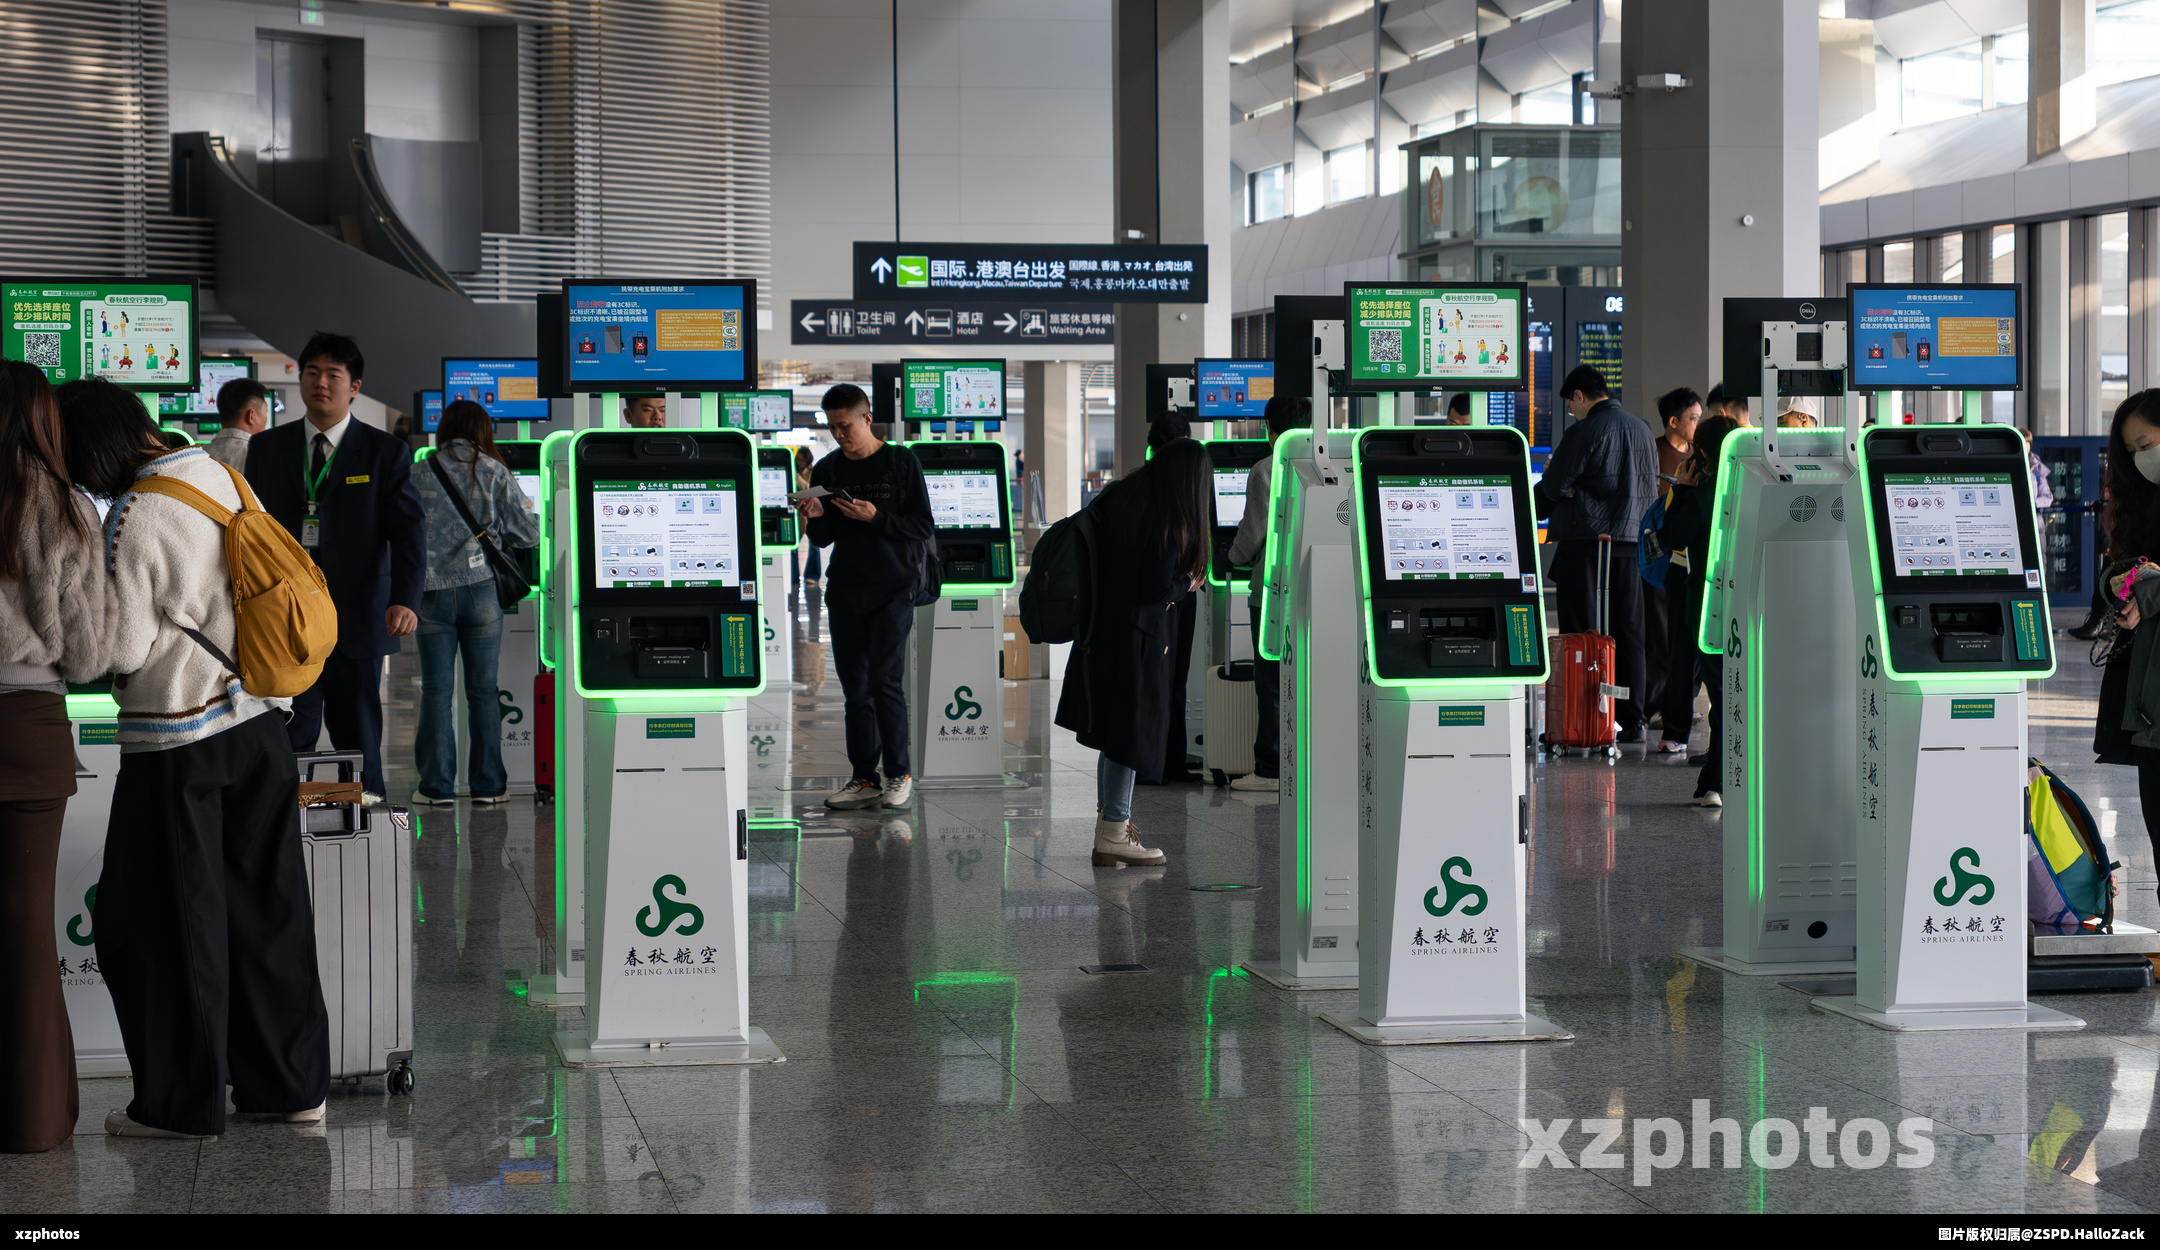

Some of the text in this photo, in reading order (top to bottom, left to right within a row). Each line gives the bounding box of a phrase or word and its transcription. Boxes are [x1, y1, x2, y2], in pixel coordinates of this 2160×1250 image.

[1029, 280, 1063, 289] Departure
[13, 302, 71, 312] 优先选择座位
[1360, 301, 1411, 309] 优先选择座位
[13, 312, 71, 321] 减少排队时间
[856, 312, 895, 325] 卫生间
[957, 312, 984, 325] 酒店
[1049, 313, 1115, 324] 旅客休息等候
[1360, 310, 1411, 318] 减少排队时间
[856, 326, 881, 335] Toilet
[957, 327, 979, 335] Hotel
[1050, 326, 1105, 336] Waiting Area
[1733, 667, 1743, 788] 春秋航空
[1868, 688, 1879, 820] 春秋航空
[1921, 915, 2005, 935] 春秋航空
[1411, 927, 1499, 946] 春秋航空
[1959, 934, 2004, 942] AIRLINES
[623, 946, 717, 966] 春秋航空
[1411, 946, 1498, 956] SPRING AIRLINES
[624, 966, 716, 977] SPRING AIRLINES
